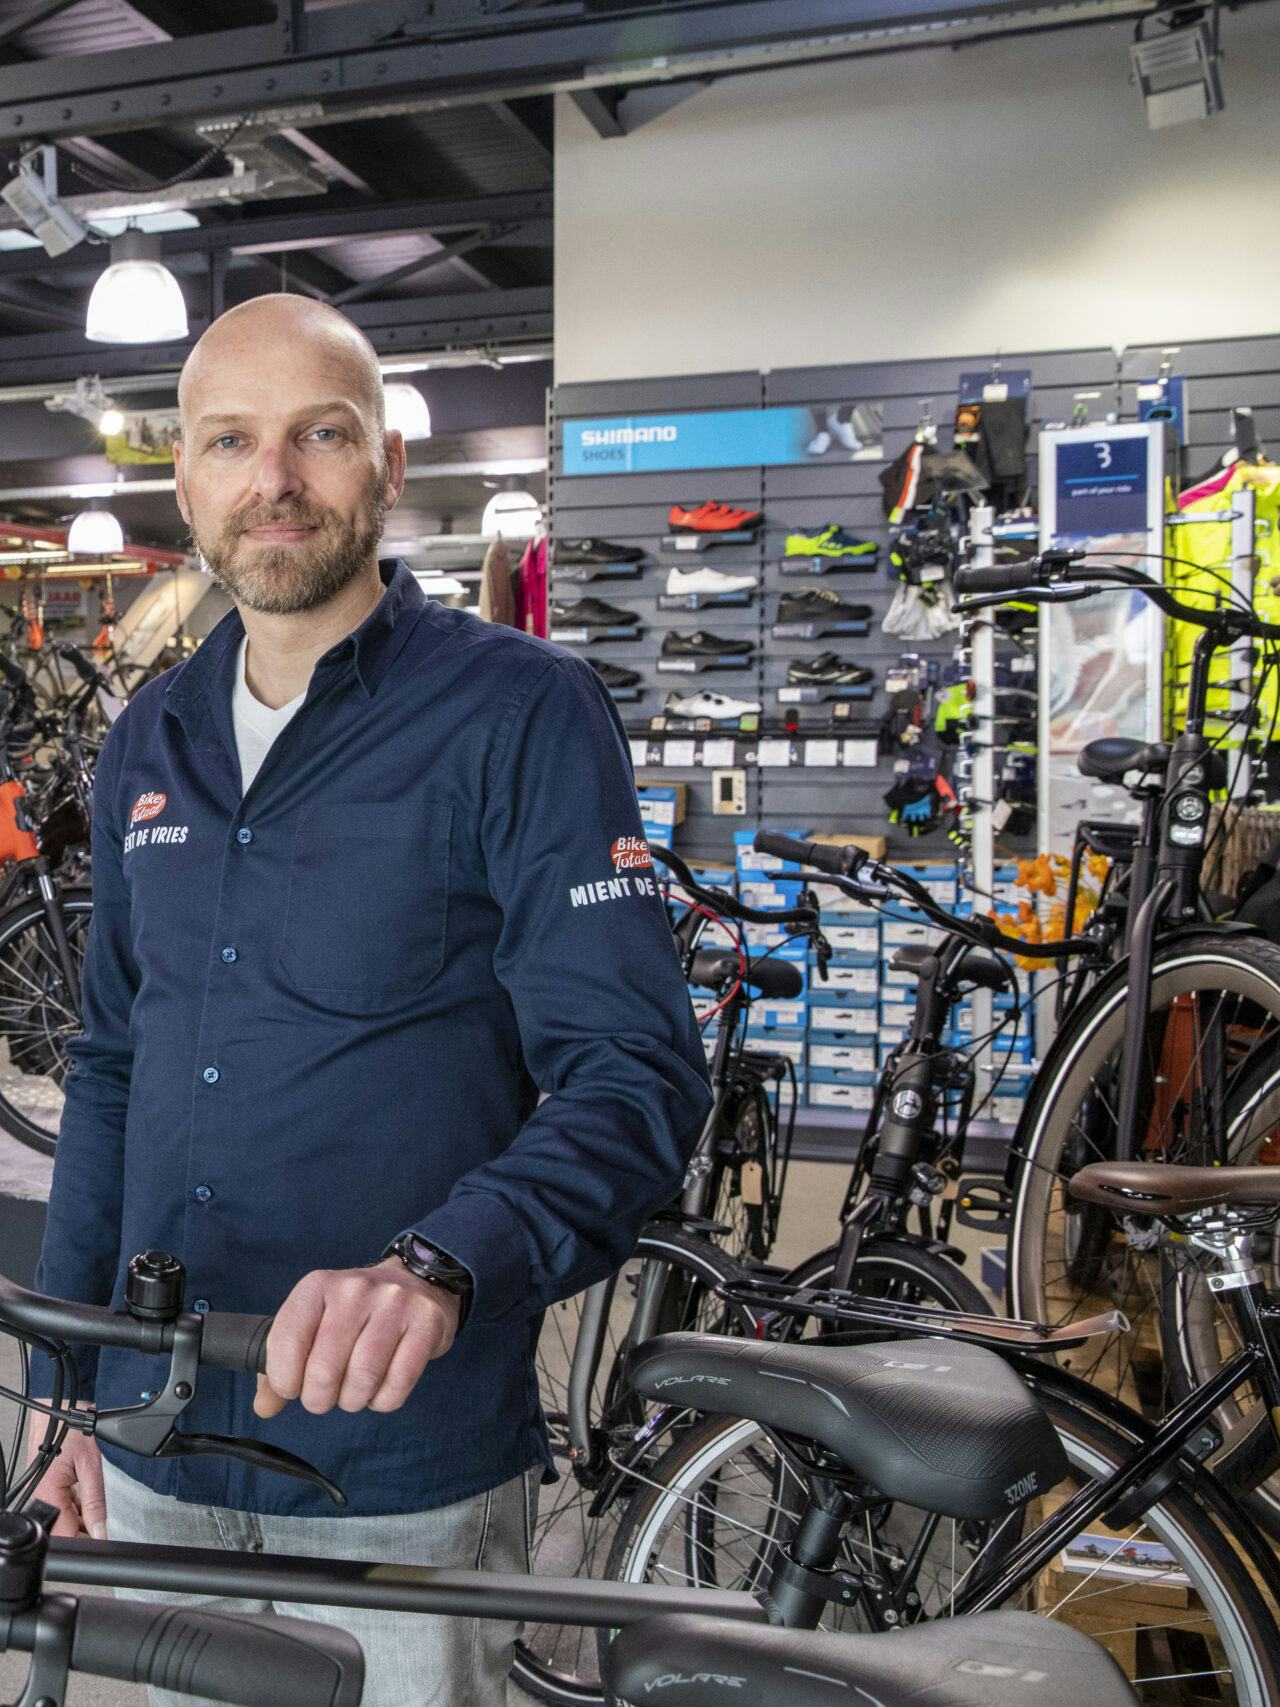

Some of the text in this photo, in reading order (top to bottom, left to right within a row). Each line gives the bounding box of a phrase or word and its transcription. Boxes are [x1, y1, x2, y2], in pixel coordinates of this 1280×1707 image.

[581, 426, 677, 446] SHIMANO
[582, 448, 625, 461] SHOES
[138, 791, 163, 807] Bike
[130, 799, 165, 829] Totaal
[124, 826, 188, 853] ENT DE VRIES
[616, 836, 648, 851] Bike
[570, 877, 655, 907] MIENT DE
[654, 1374, 732, 1390] VOLARE
[1004, 1471, 1038, 1505] 3ZONE
[644, 1673, 747, 1692] VOLARE
